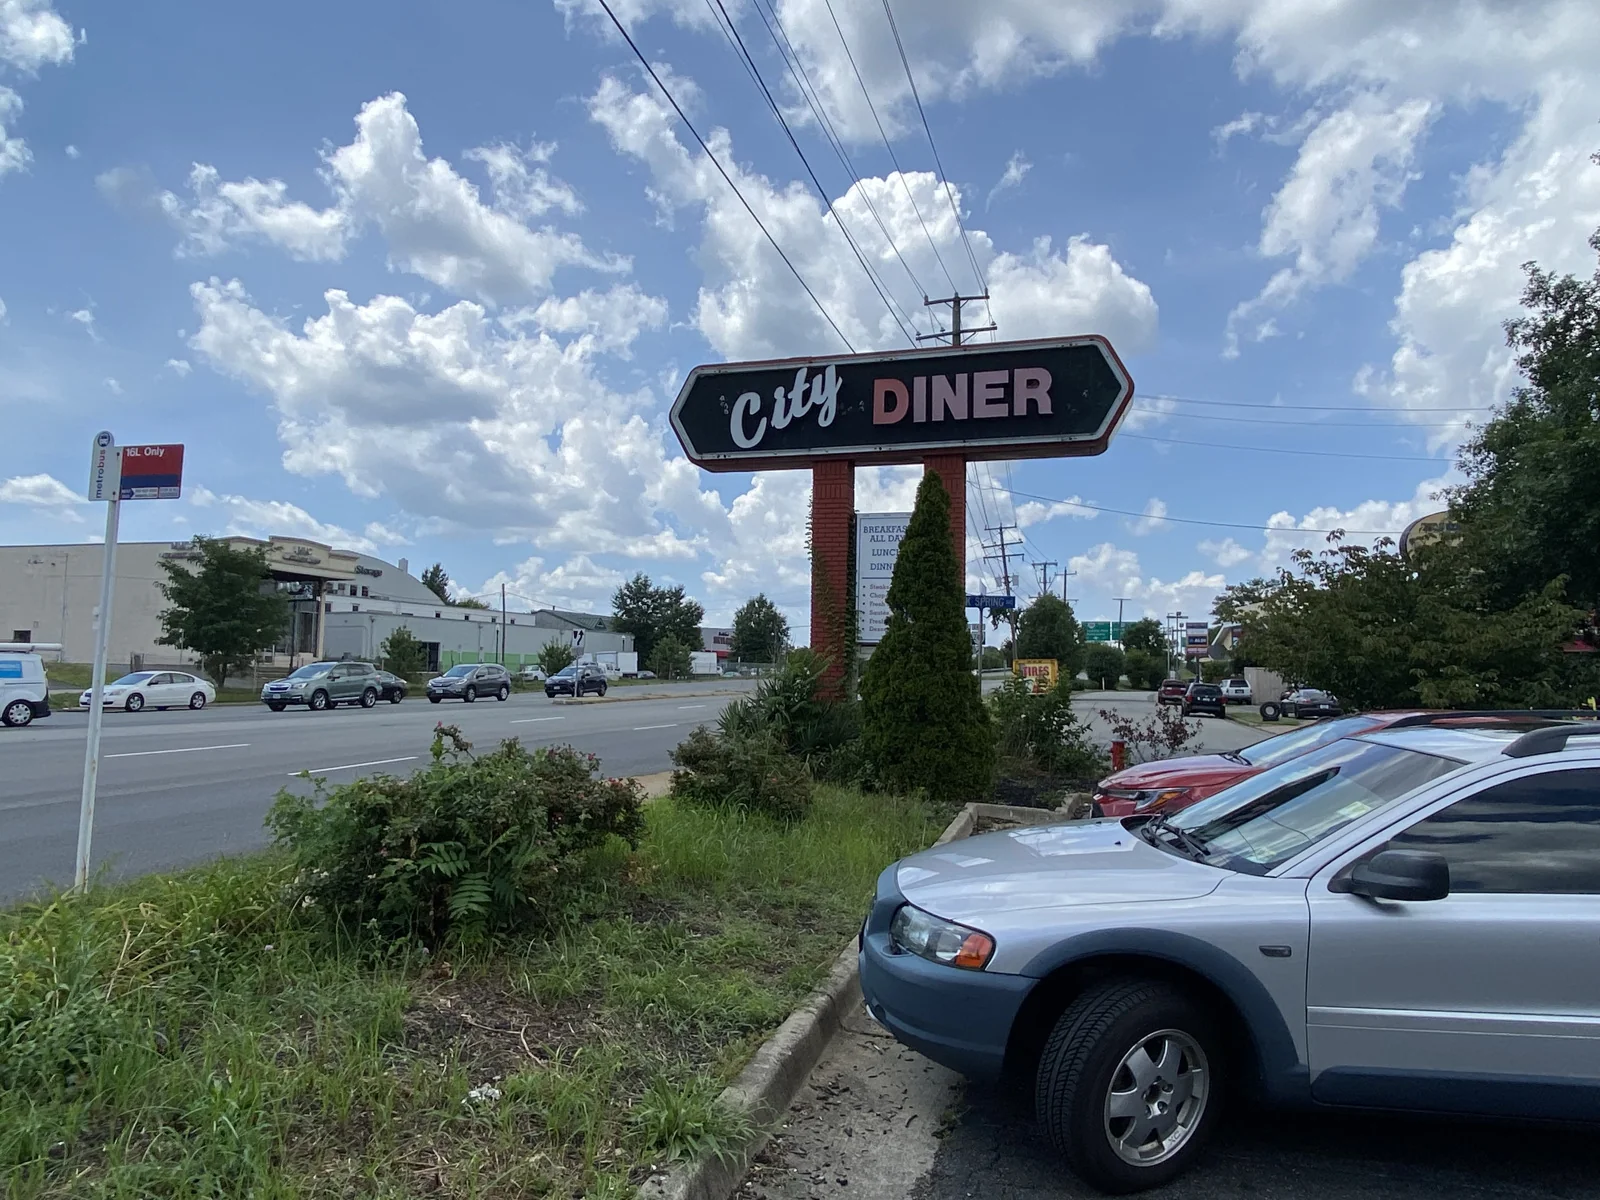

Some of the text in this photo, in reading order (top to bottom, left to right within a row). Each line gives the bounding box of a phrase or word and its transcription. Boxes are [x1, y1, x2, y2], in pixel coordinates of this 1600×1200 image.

[730, 364, 1054, 449] City DINER
[126, 446, 165, 458] 16L Only
[95, 449, 106, 499] metrobus
[863, 525, 908, 534] BREAKFAS
[869, 534, 886, 543] ALL
[870, 562, 893, 571] DINN
[869, 592, 886, 600] Chop
[974, 597, 1005, 608] SPRING
[1023, 665, 1050, 677] TIRES
